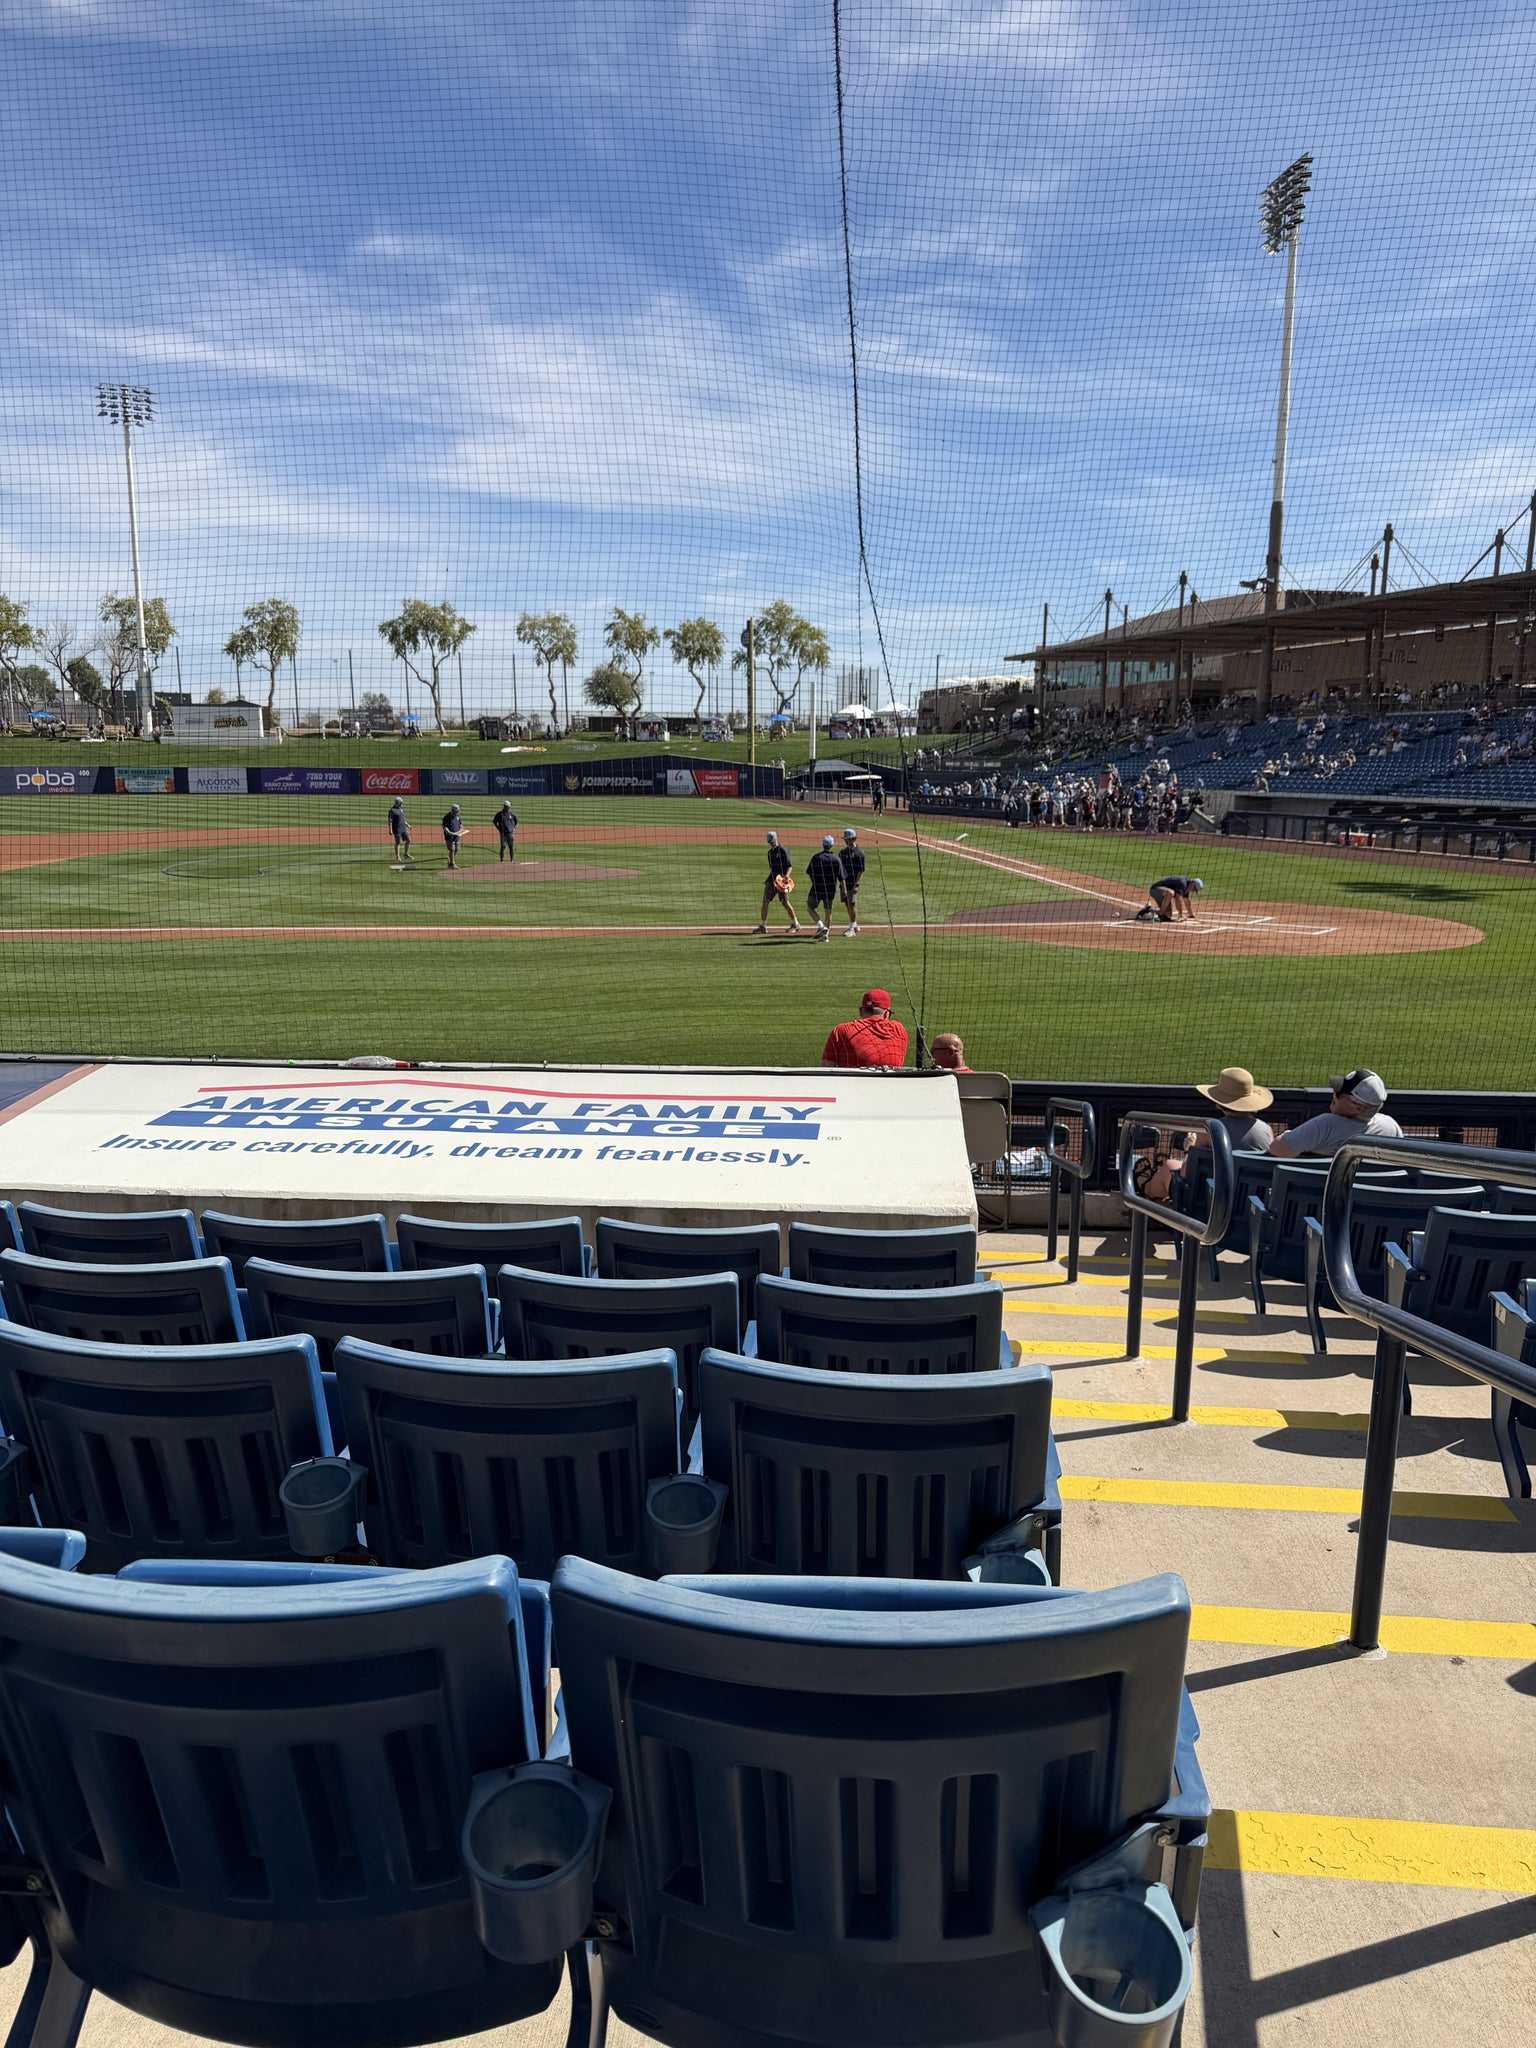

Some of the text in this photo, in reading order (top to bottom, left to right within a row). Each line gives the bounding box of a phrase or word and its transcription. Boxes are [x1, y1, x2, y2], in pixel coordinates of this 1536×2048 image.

[16, 769, 75, 790] poba
[197, 778, 240, 787] ALGODON
[309, 781, 340, 789] PURPOSE
[365, 773, 414, 789] Coca-Cola
[442, 772, 479, 783] WALTZ
[179, 1095, 823, 1121] AMERICAN FAMILY
[203, 1114, 766, 1136] INSURANCE
[98, 1134, 811, 1168] Insure carefully, dream fearlessly.
